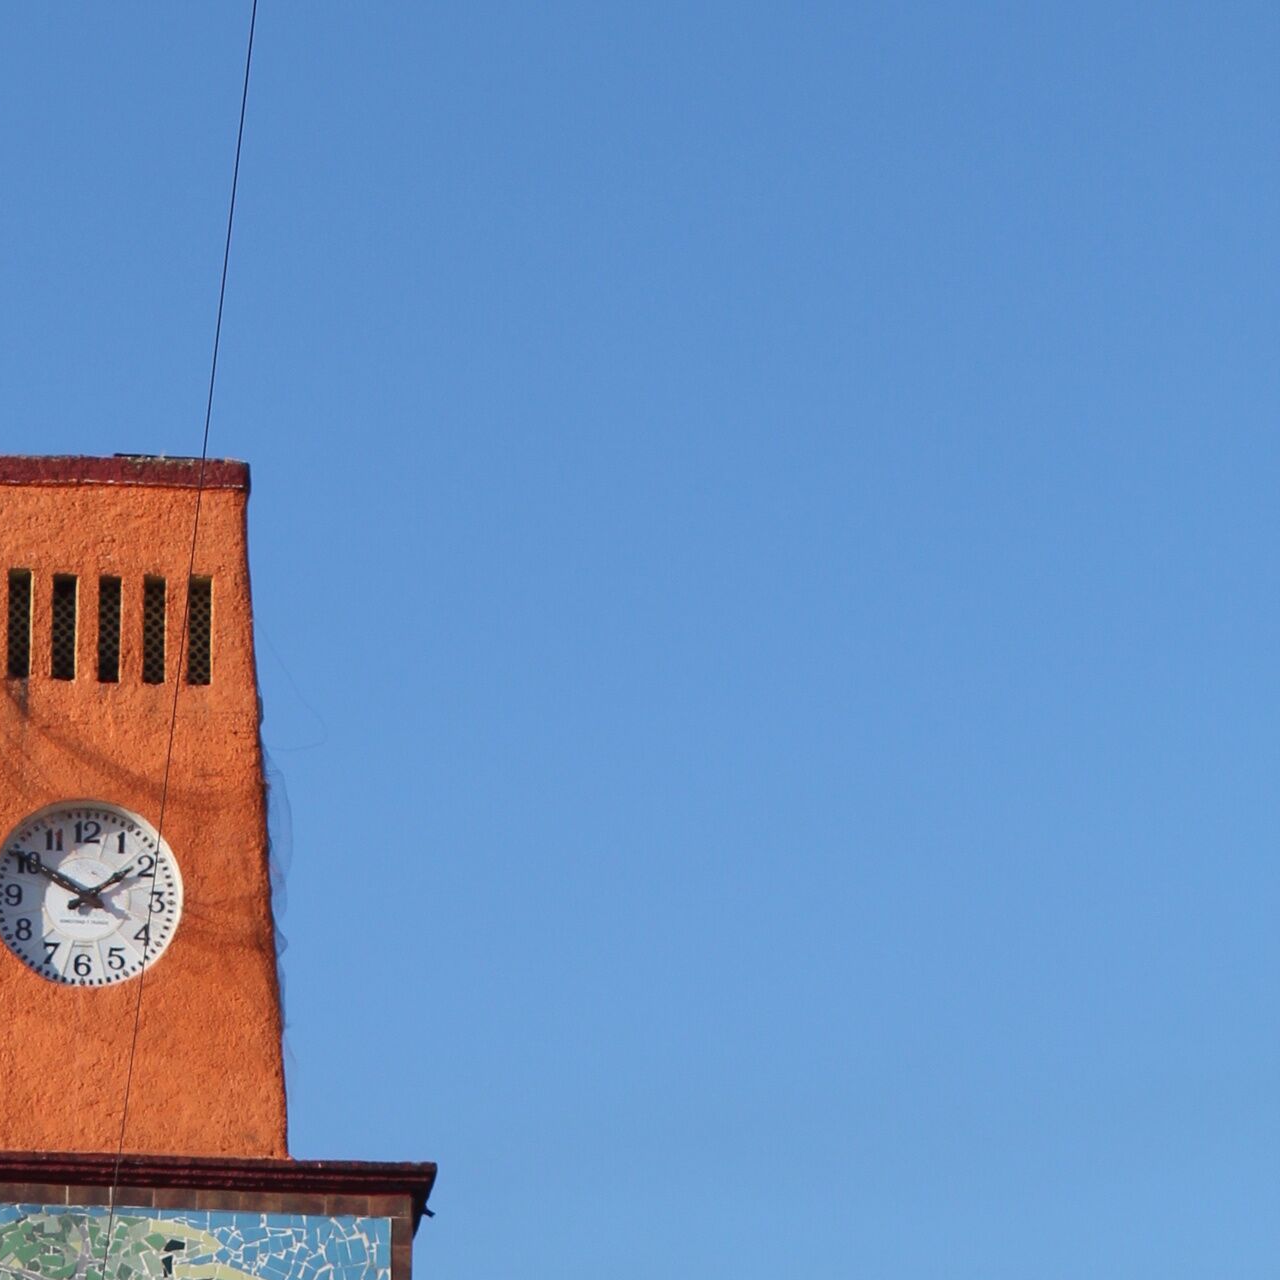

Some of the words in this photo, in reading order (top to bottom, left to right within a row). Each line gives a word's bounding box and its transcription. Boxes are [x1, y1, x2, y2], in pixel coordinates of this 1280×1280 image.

[46, 828, 63, 851] 11
[74, 821, 101, 843] 12
[117, 831, 126, 854] 1
[17, 851, 41, 875] 10
[137, 855, 155, 878] 2
[5, 884, 21, 906] 9
[148, 891, 166, 914] 3
[15, 918, 32, 941] 8
[134, 924, 150, 947] 4
[43, 942, 60, 965] 7
[74, 954, 91, 976] 6
[108, 947, 126, 970] 5
